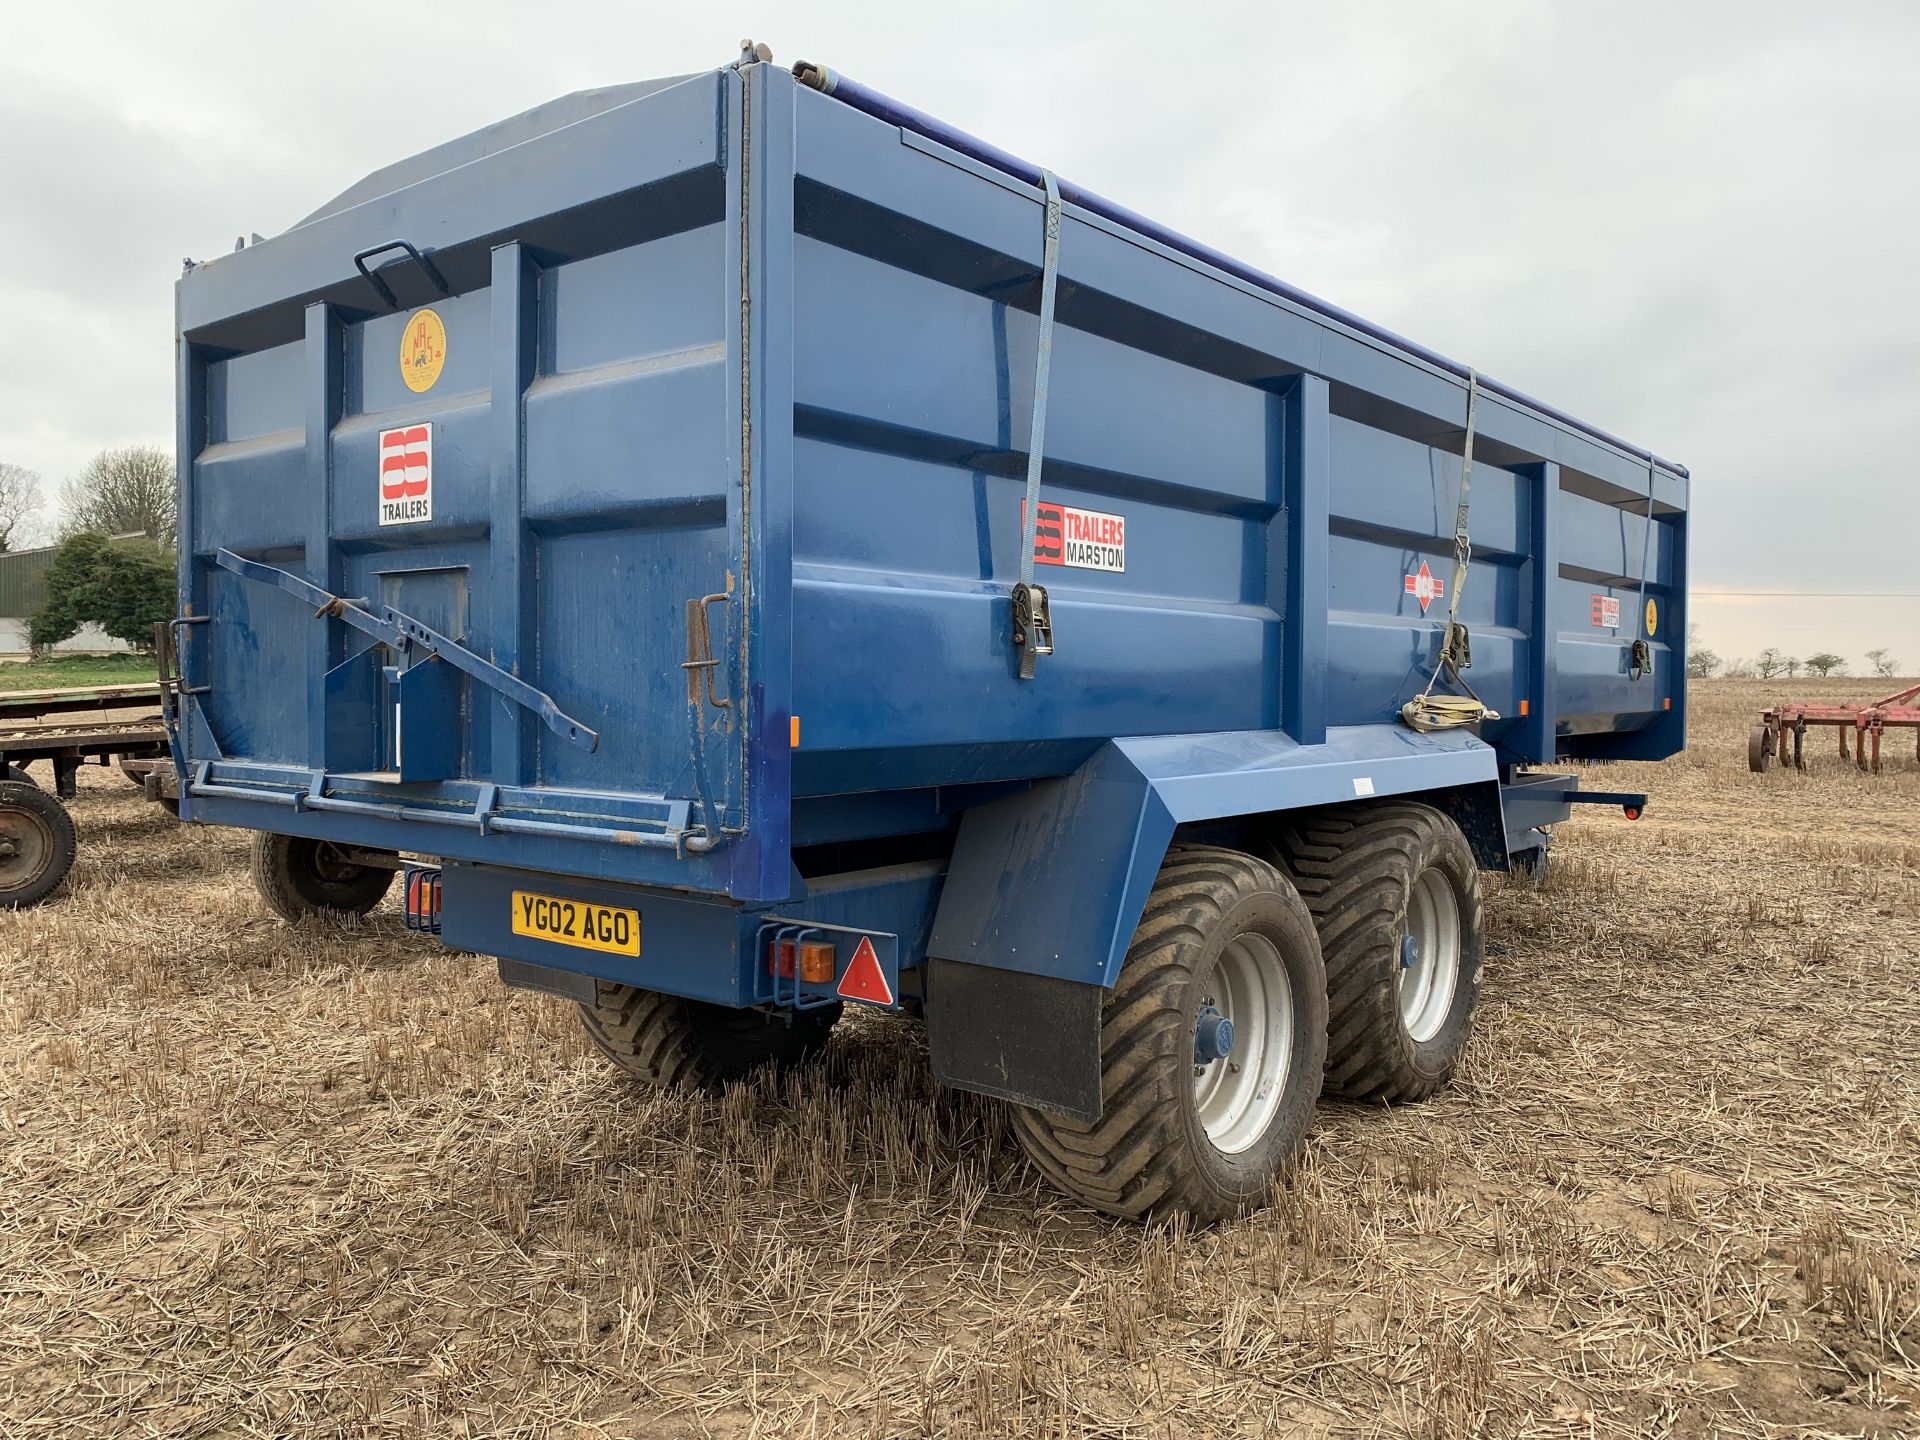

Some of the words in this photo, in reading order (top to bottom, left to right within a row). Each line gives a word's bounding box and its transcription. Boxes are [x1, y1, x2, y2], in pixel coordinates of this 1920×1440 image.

[383, 500, 428, 521] TRAILERS
[1066, 513, 1123, 546] TRAILERS
[1066, 542, 1123, 568] MARSTON
[522, 895, 576, 937] YG02
[583, 907, 629, 946] AGO
